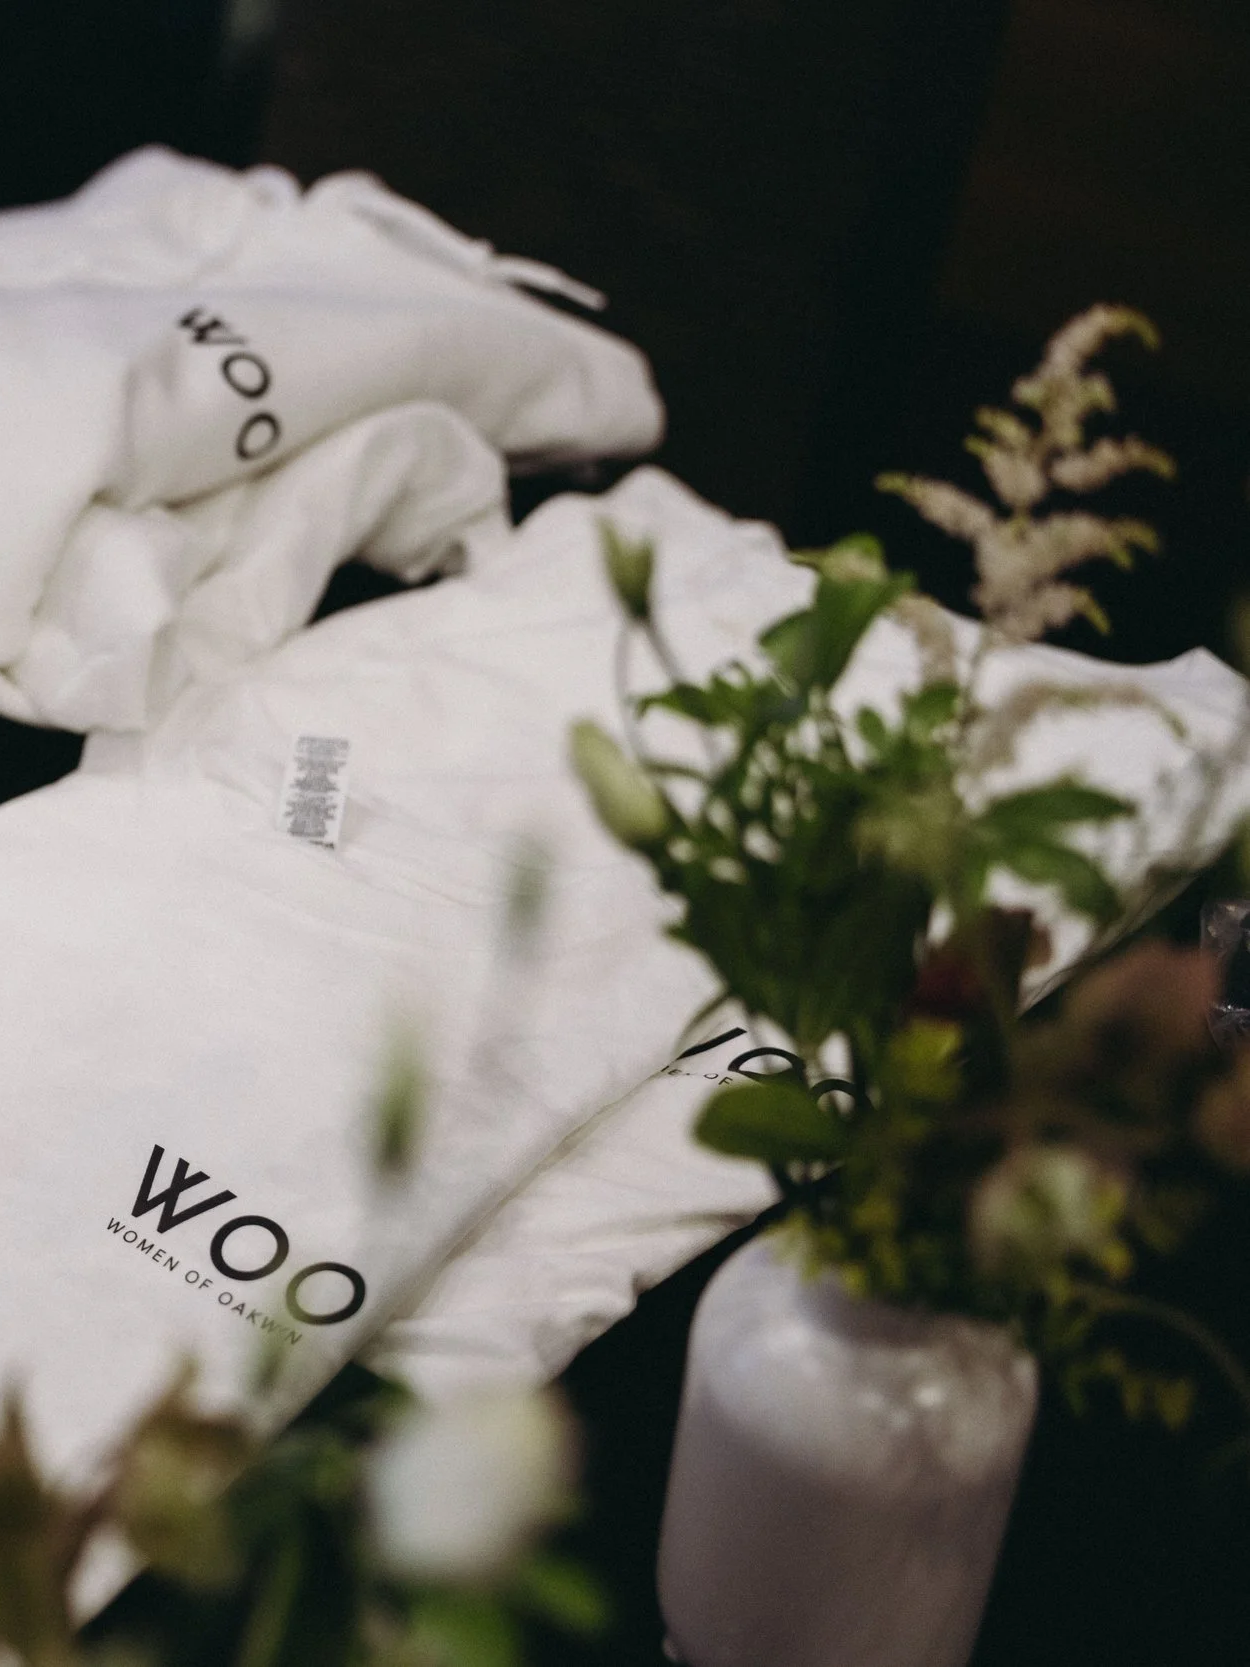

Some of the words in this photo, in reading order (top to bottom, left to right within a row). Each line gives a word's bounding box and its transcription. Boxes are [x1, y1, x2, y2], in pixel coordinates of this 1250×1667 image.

[178, 307, 282, 463] WOO
[106, 1217, 180, 1272] WOMEN
[184, 1270, 214, 1289] OF
[130, 1143, 367, 1327] WOO
